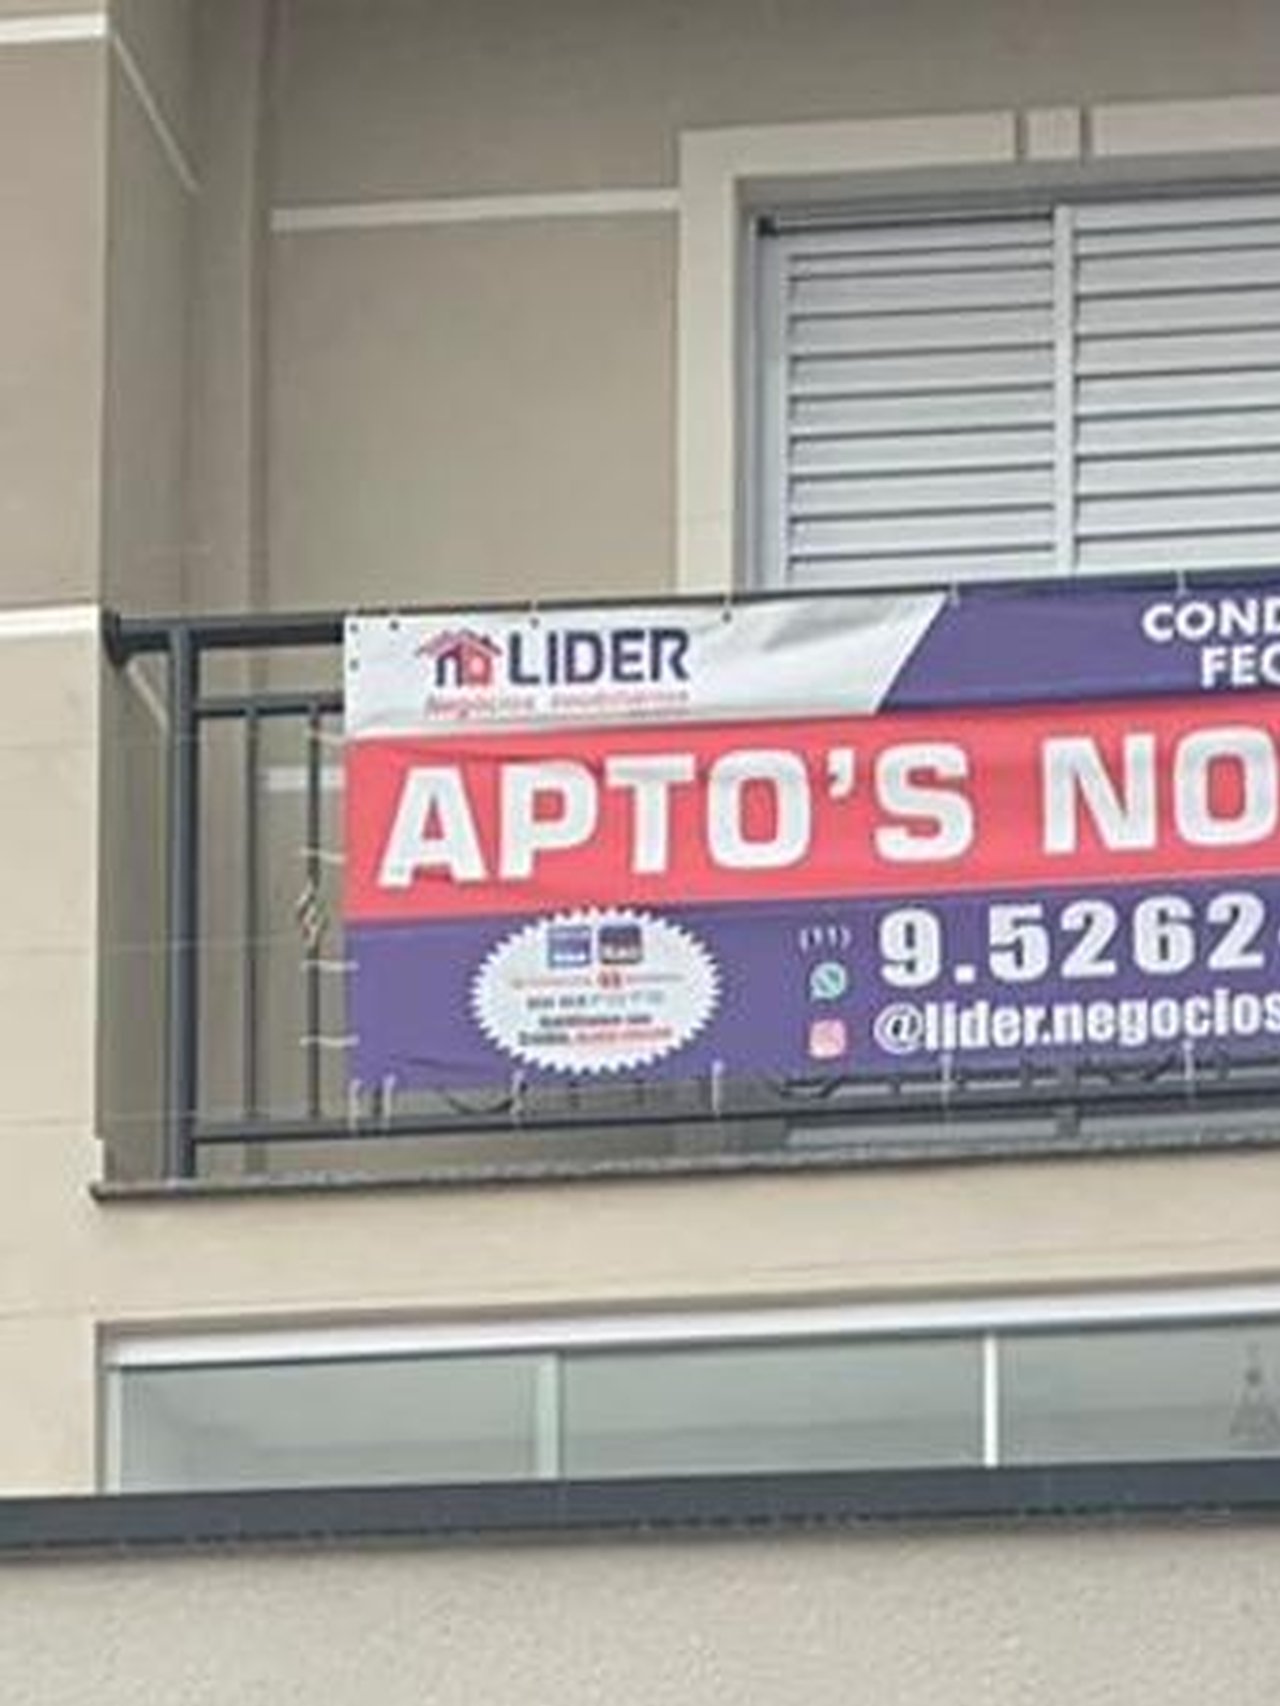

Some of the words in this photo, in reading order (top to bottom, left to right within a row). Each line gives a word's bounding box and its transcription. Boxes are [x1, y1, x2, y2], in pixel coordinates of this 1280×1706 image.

[508, 628, 690, 685] LIDER
[379, 743, 973, 888] APTO'S
[800, 925, 852, 952] (11)
